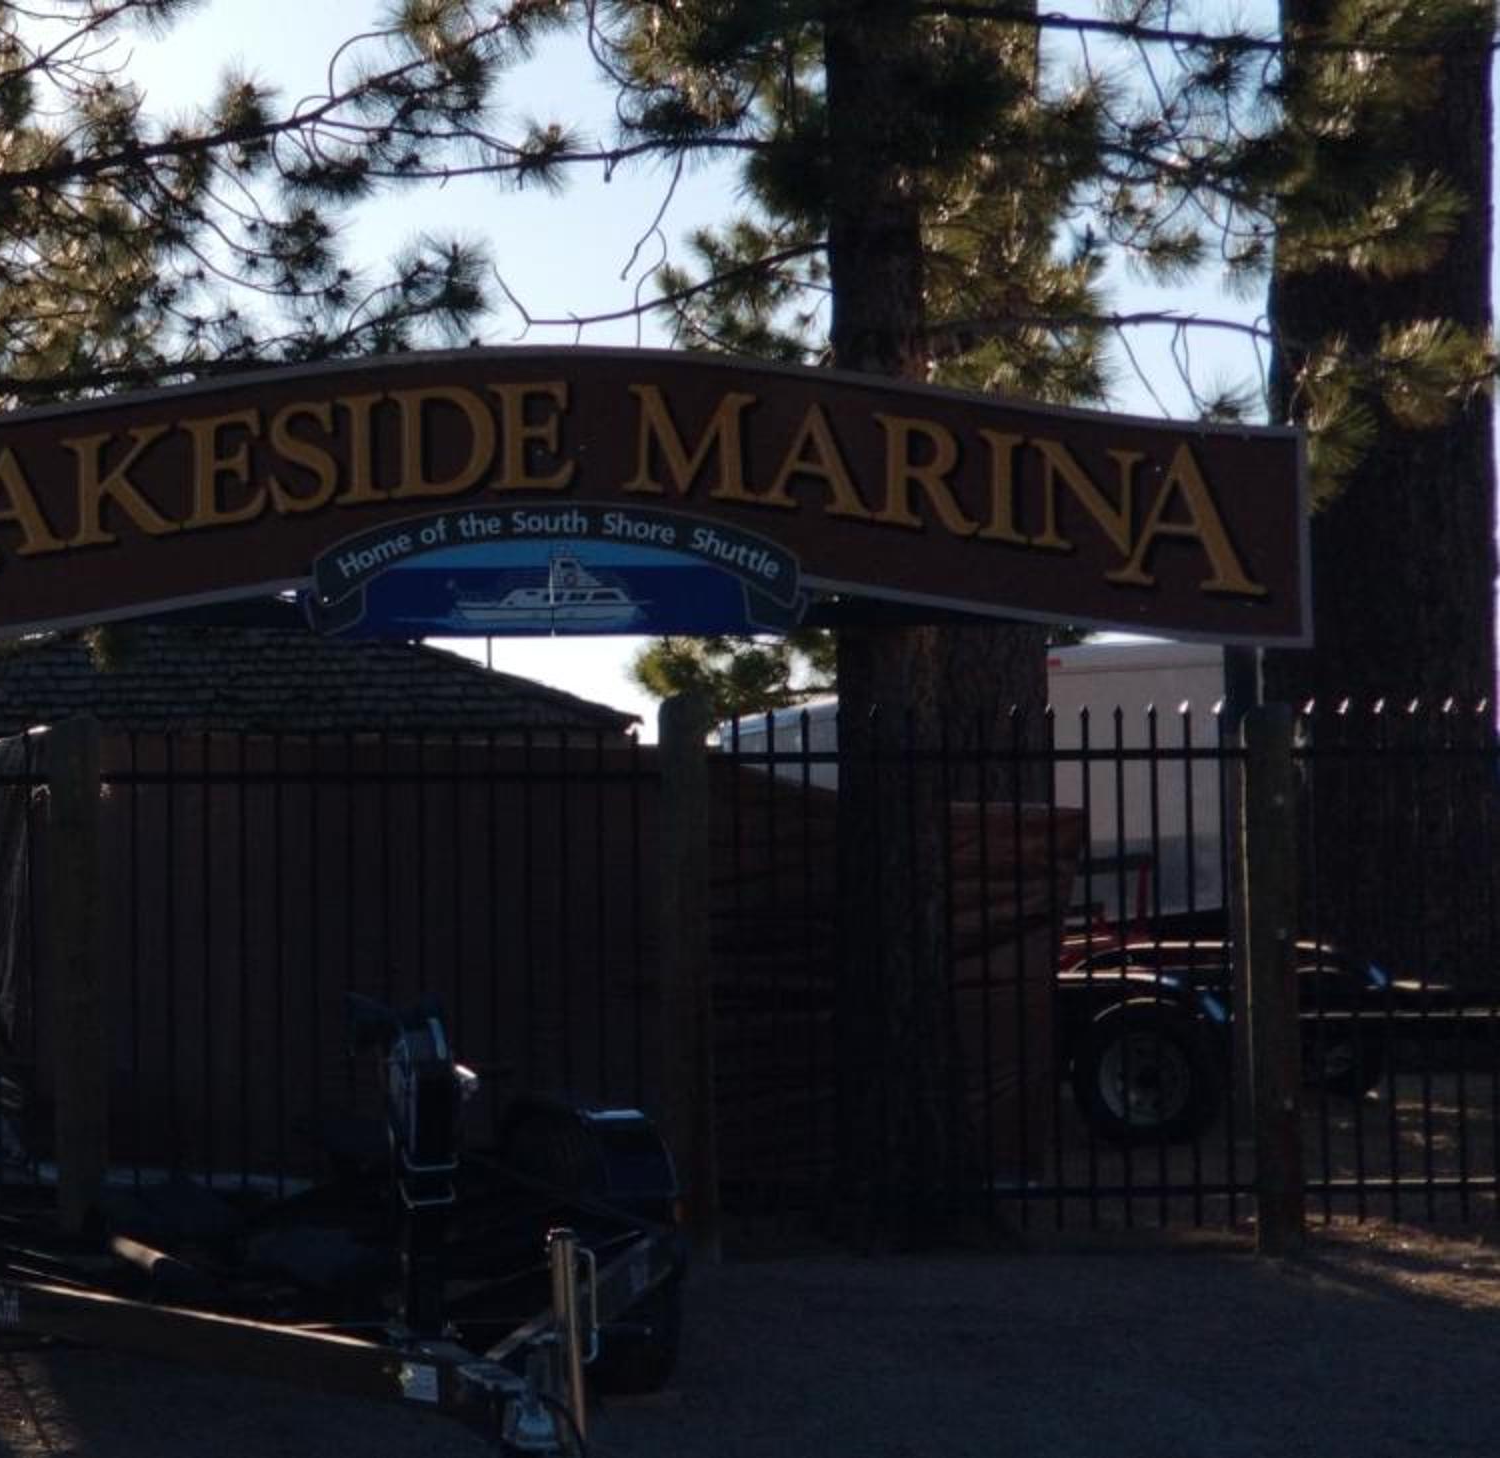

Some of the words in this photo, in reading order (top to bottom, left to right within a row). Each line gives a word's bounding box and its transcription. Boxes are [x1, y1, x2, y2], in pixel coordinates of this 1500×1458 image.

[337, 533, 411, 579] Home
[419, 514, 449, 546] of
[458, 510, 501, 537] the
[511, 509, 589, 537] South
[602, 511, 676, 545] Shore
[691, 526, 781, 580] Shuttle
[622, 382, 1270, 597] MARINA
